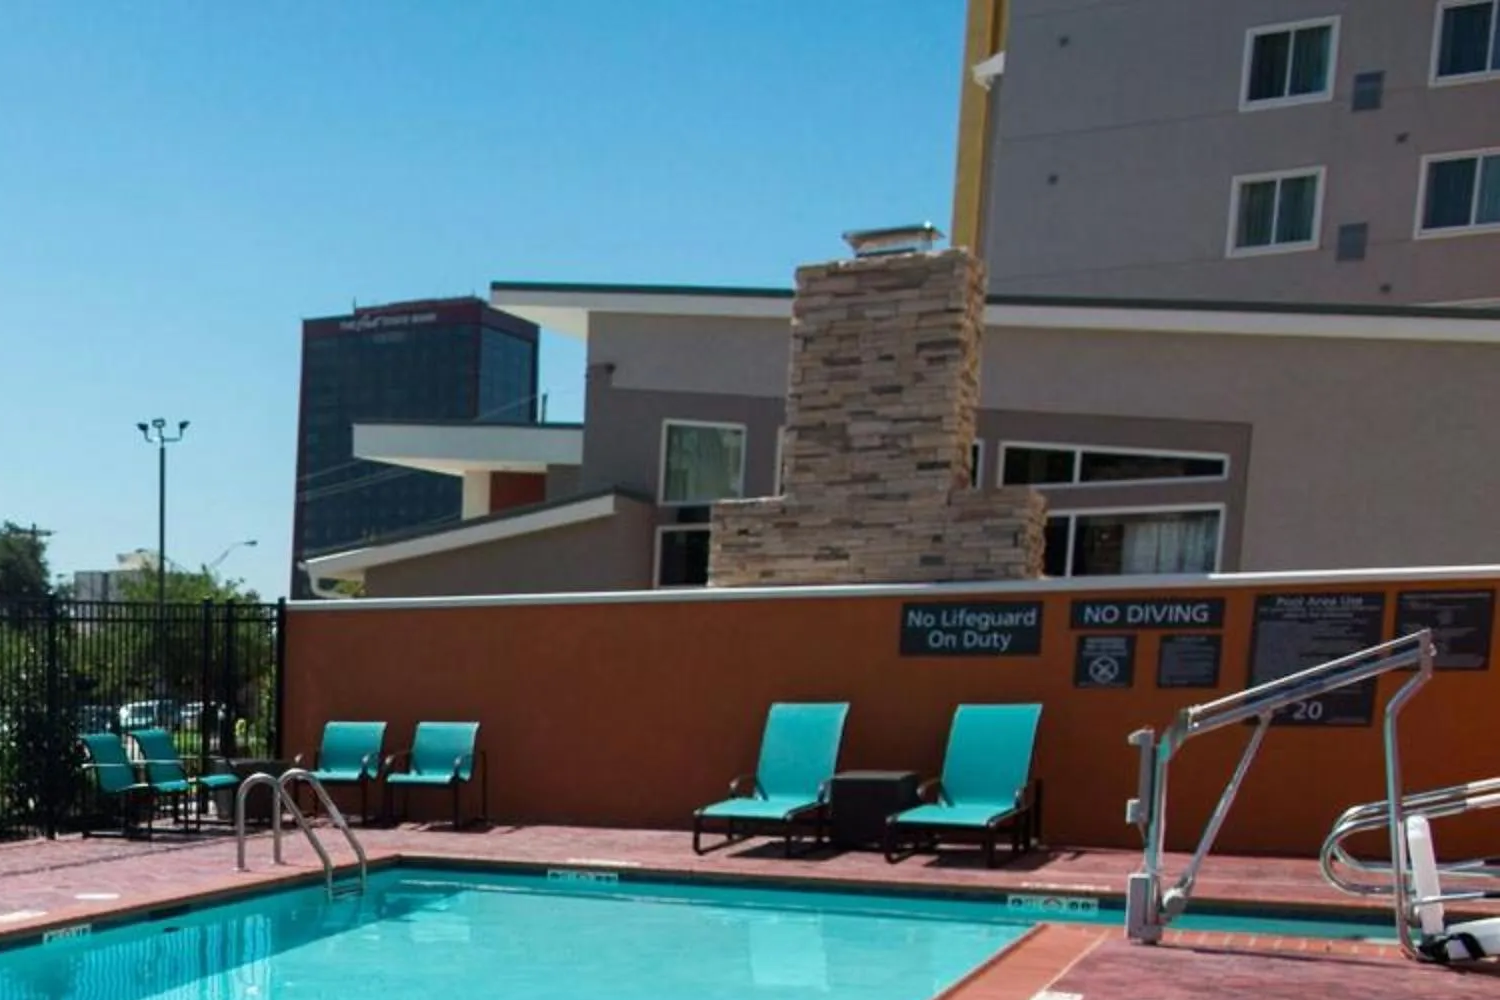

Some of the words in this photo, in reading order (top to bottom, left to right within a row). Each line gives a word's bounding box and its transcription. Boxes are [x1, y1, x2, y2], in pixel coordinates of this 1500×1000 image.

[907, 610, 936, 627] No
[940, 607, 1037, 631] Lifeguard
[1084, 604, 1120, 624] NO
[1126, 603, 1209, 623] DIVING
[928, 630, 956, 648] On
[962, 630, 1012, 652] Duty
[1292, 701, 1323, 720] 20
